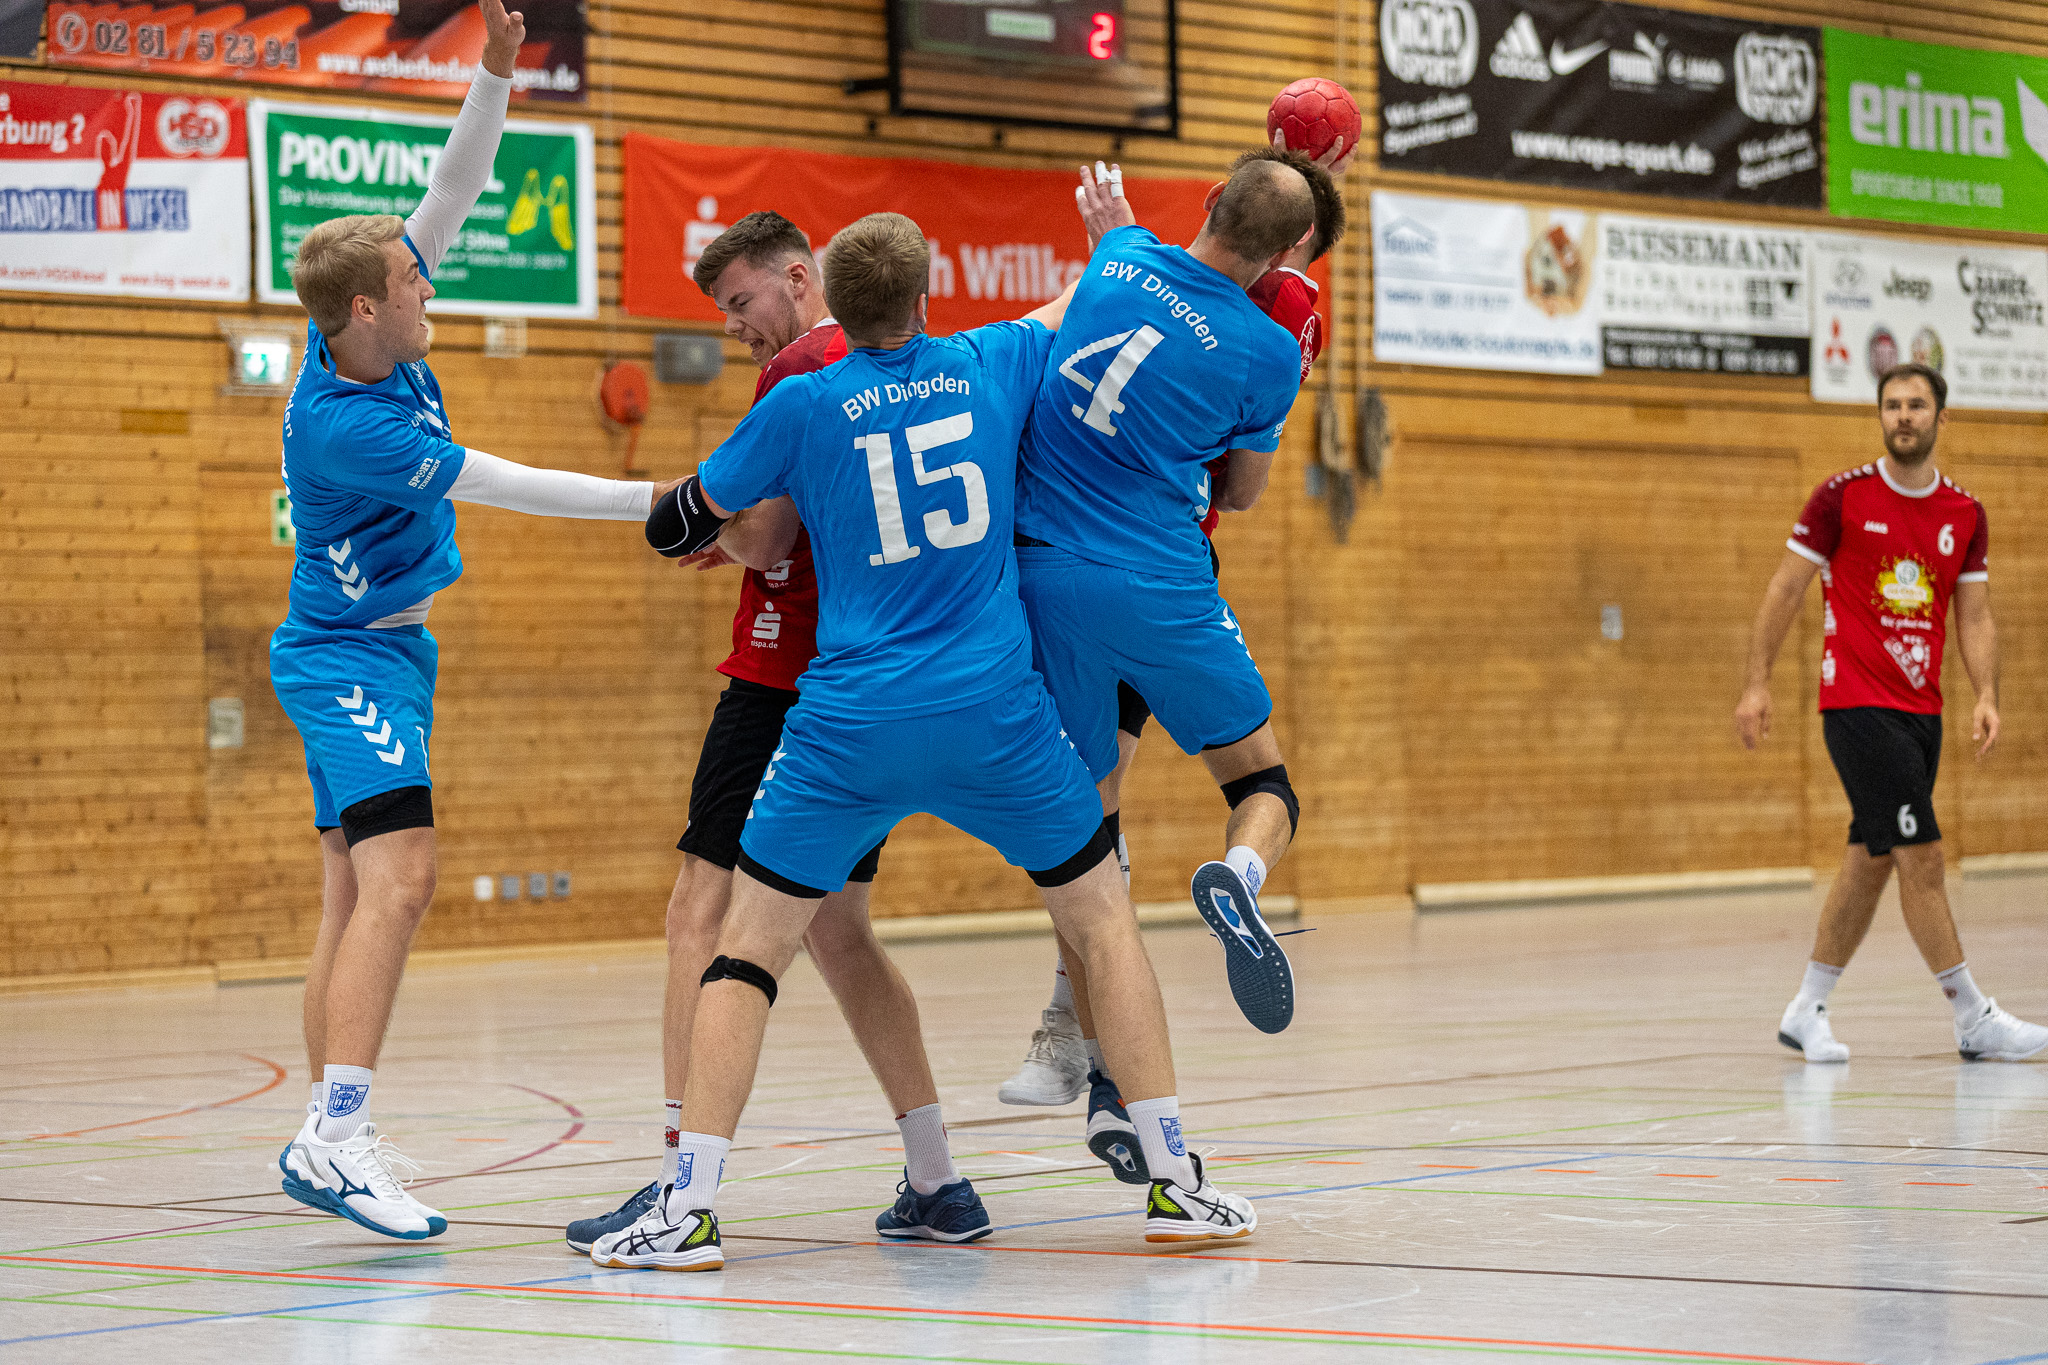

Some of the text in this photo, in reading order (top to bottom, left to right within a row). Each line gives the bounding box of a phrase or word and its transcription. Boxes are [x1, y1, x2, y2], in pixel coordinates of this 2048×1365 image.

[95, 19, 130, 56] 02
[1088, 12, 1115, 60] 2
[1489, 54, 1551, 82] adidas
[1608, 50, 1658, 84] PUMA
[1849, 71, 2006, 160] erima
[101, 189, 122, 228] IN
[126, 190, 188, 230] WESEL
[1606, 226, 1803, 271] BIESEMANN
[1881, 265, 1934, 305] Jeep
[1101, 261, 1219, 351] BW Dingden
[842, 372, 970, 422] BW Dingden
[1058, 324, 1166, 437] 4
[408, 457, 434, 488] SPORT
[854, 411, 990, 567] 15
[1937, 523, 1955, 556] 6
[1897, 803, 1919, 838] 6
